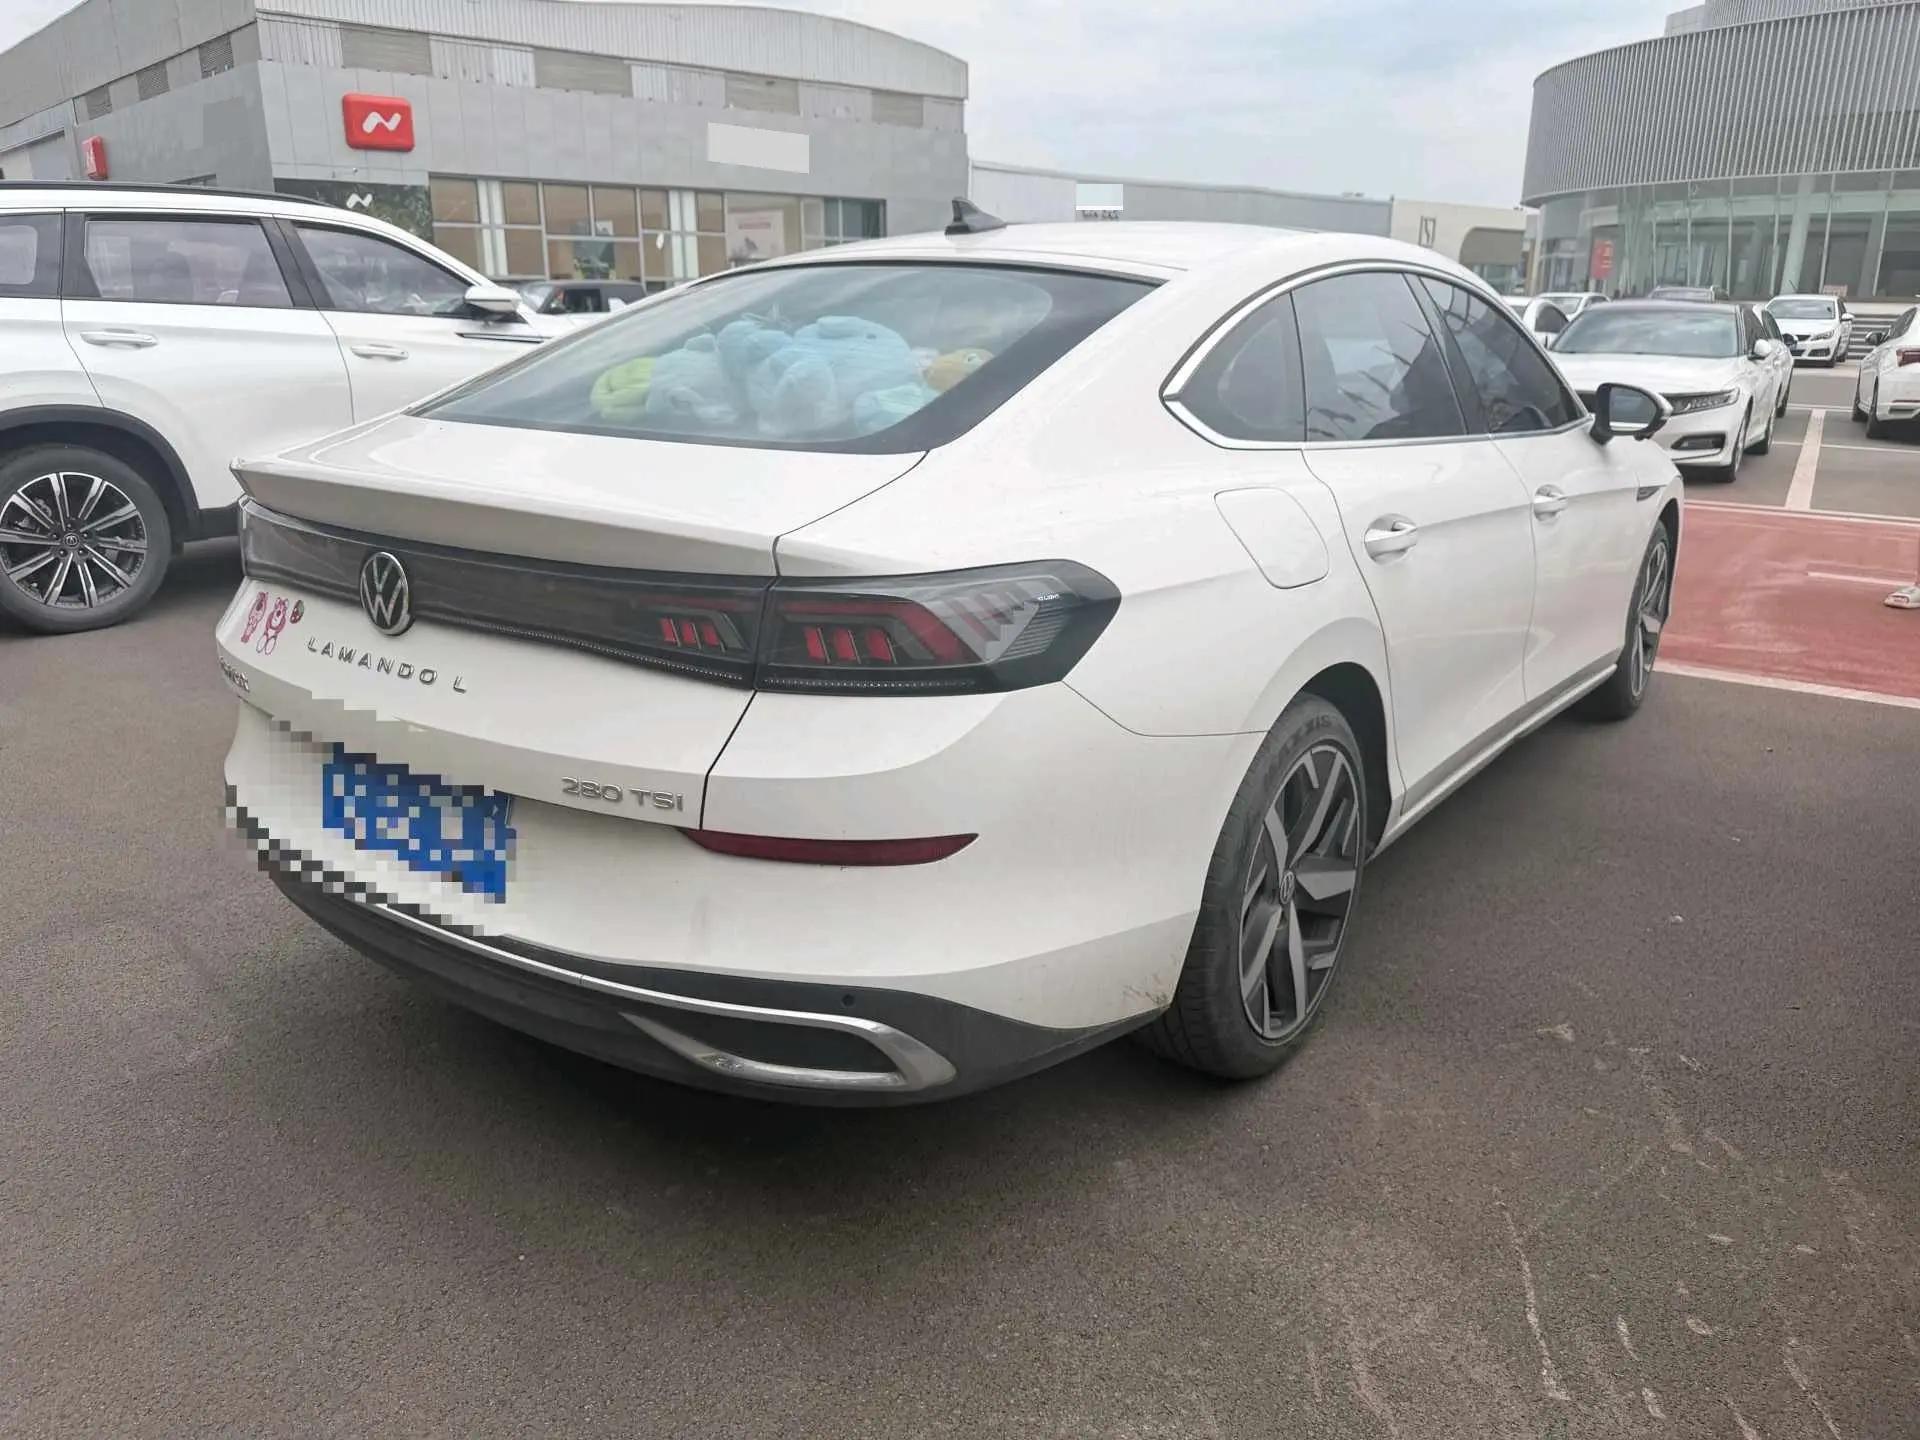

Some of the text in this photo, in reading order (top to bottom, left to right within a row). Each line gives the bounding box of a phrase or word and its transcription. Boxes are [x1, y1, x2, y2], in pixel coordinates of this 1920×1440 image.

[307, 637, 467, 694] LAMANDO L
[561, 776, 684, 812] 280 TSI
